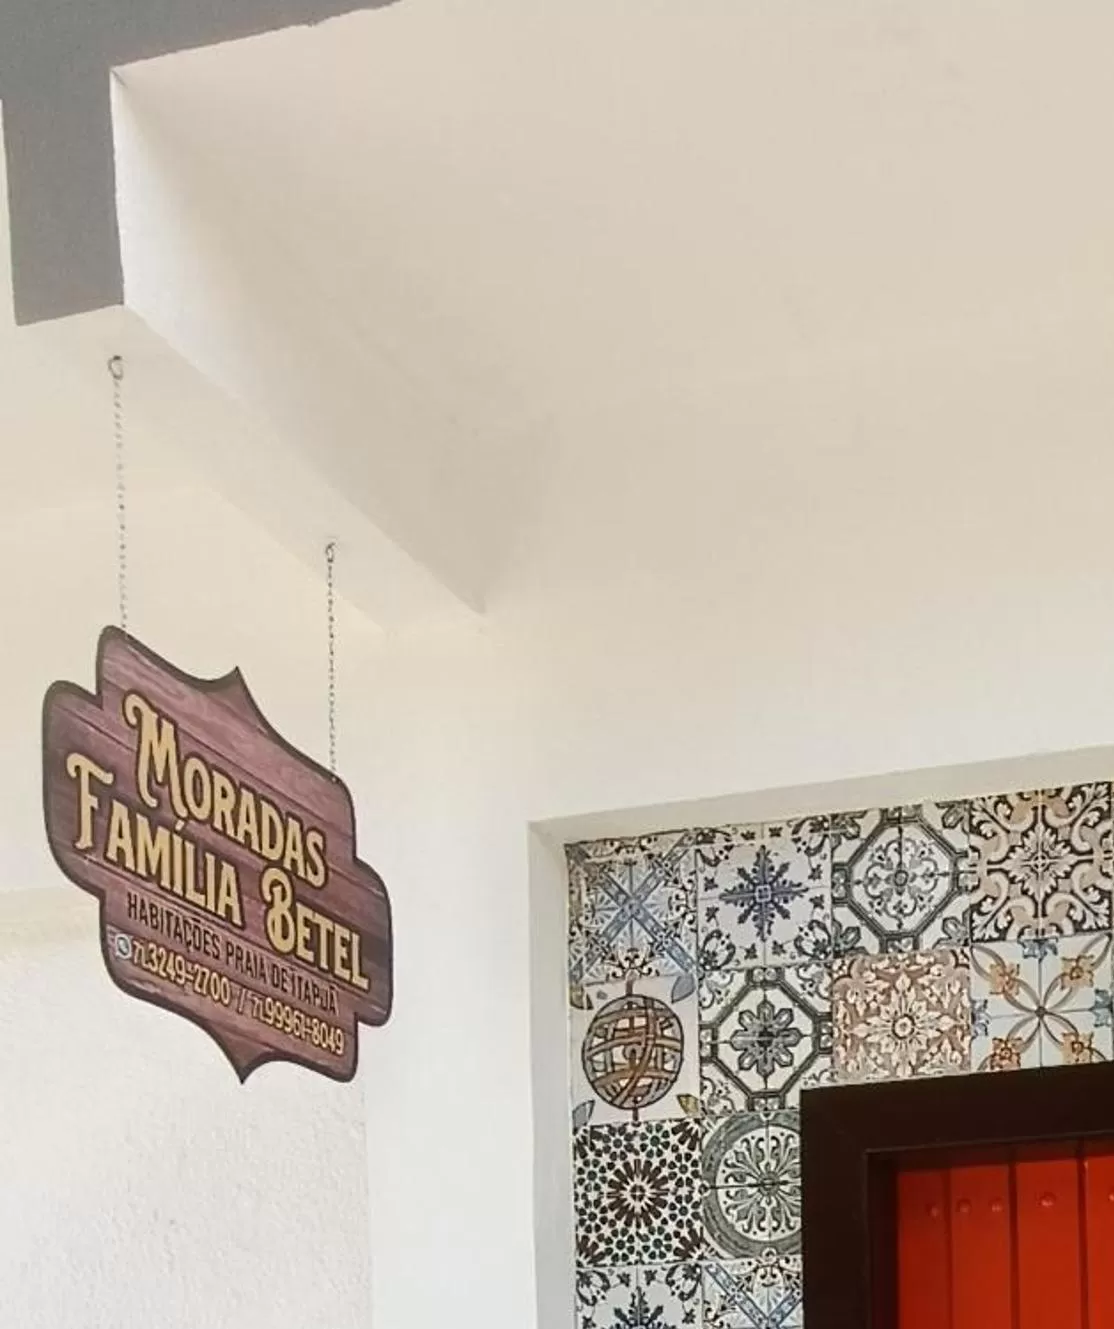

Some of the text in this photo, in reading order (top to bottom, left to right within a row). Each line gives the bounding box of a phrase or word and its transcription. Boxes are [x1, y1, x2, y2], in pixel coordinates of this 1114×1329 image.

[66, 752, 369, 991] FAMÍLIA BETEL
[122, 692, 328, 888] MORADAS
[226, 940, 268, 982] PRAIA
[271, 962, 291, 994] DE
